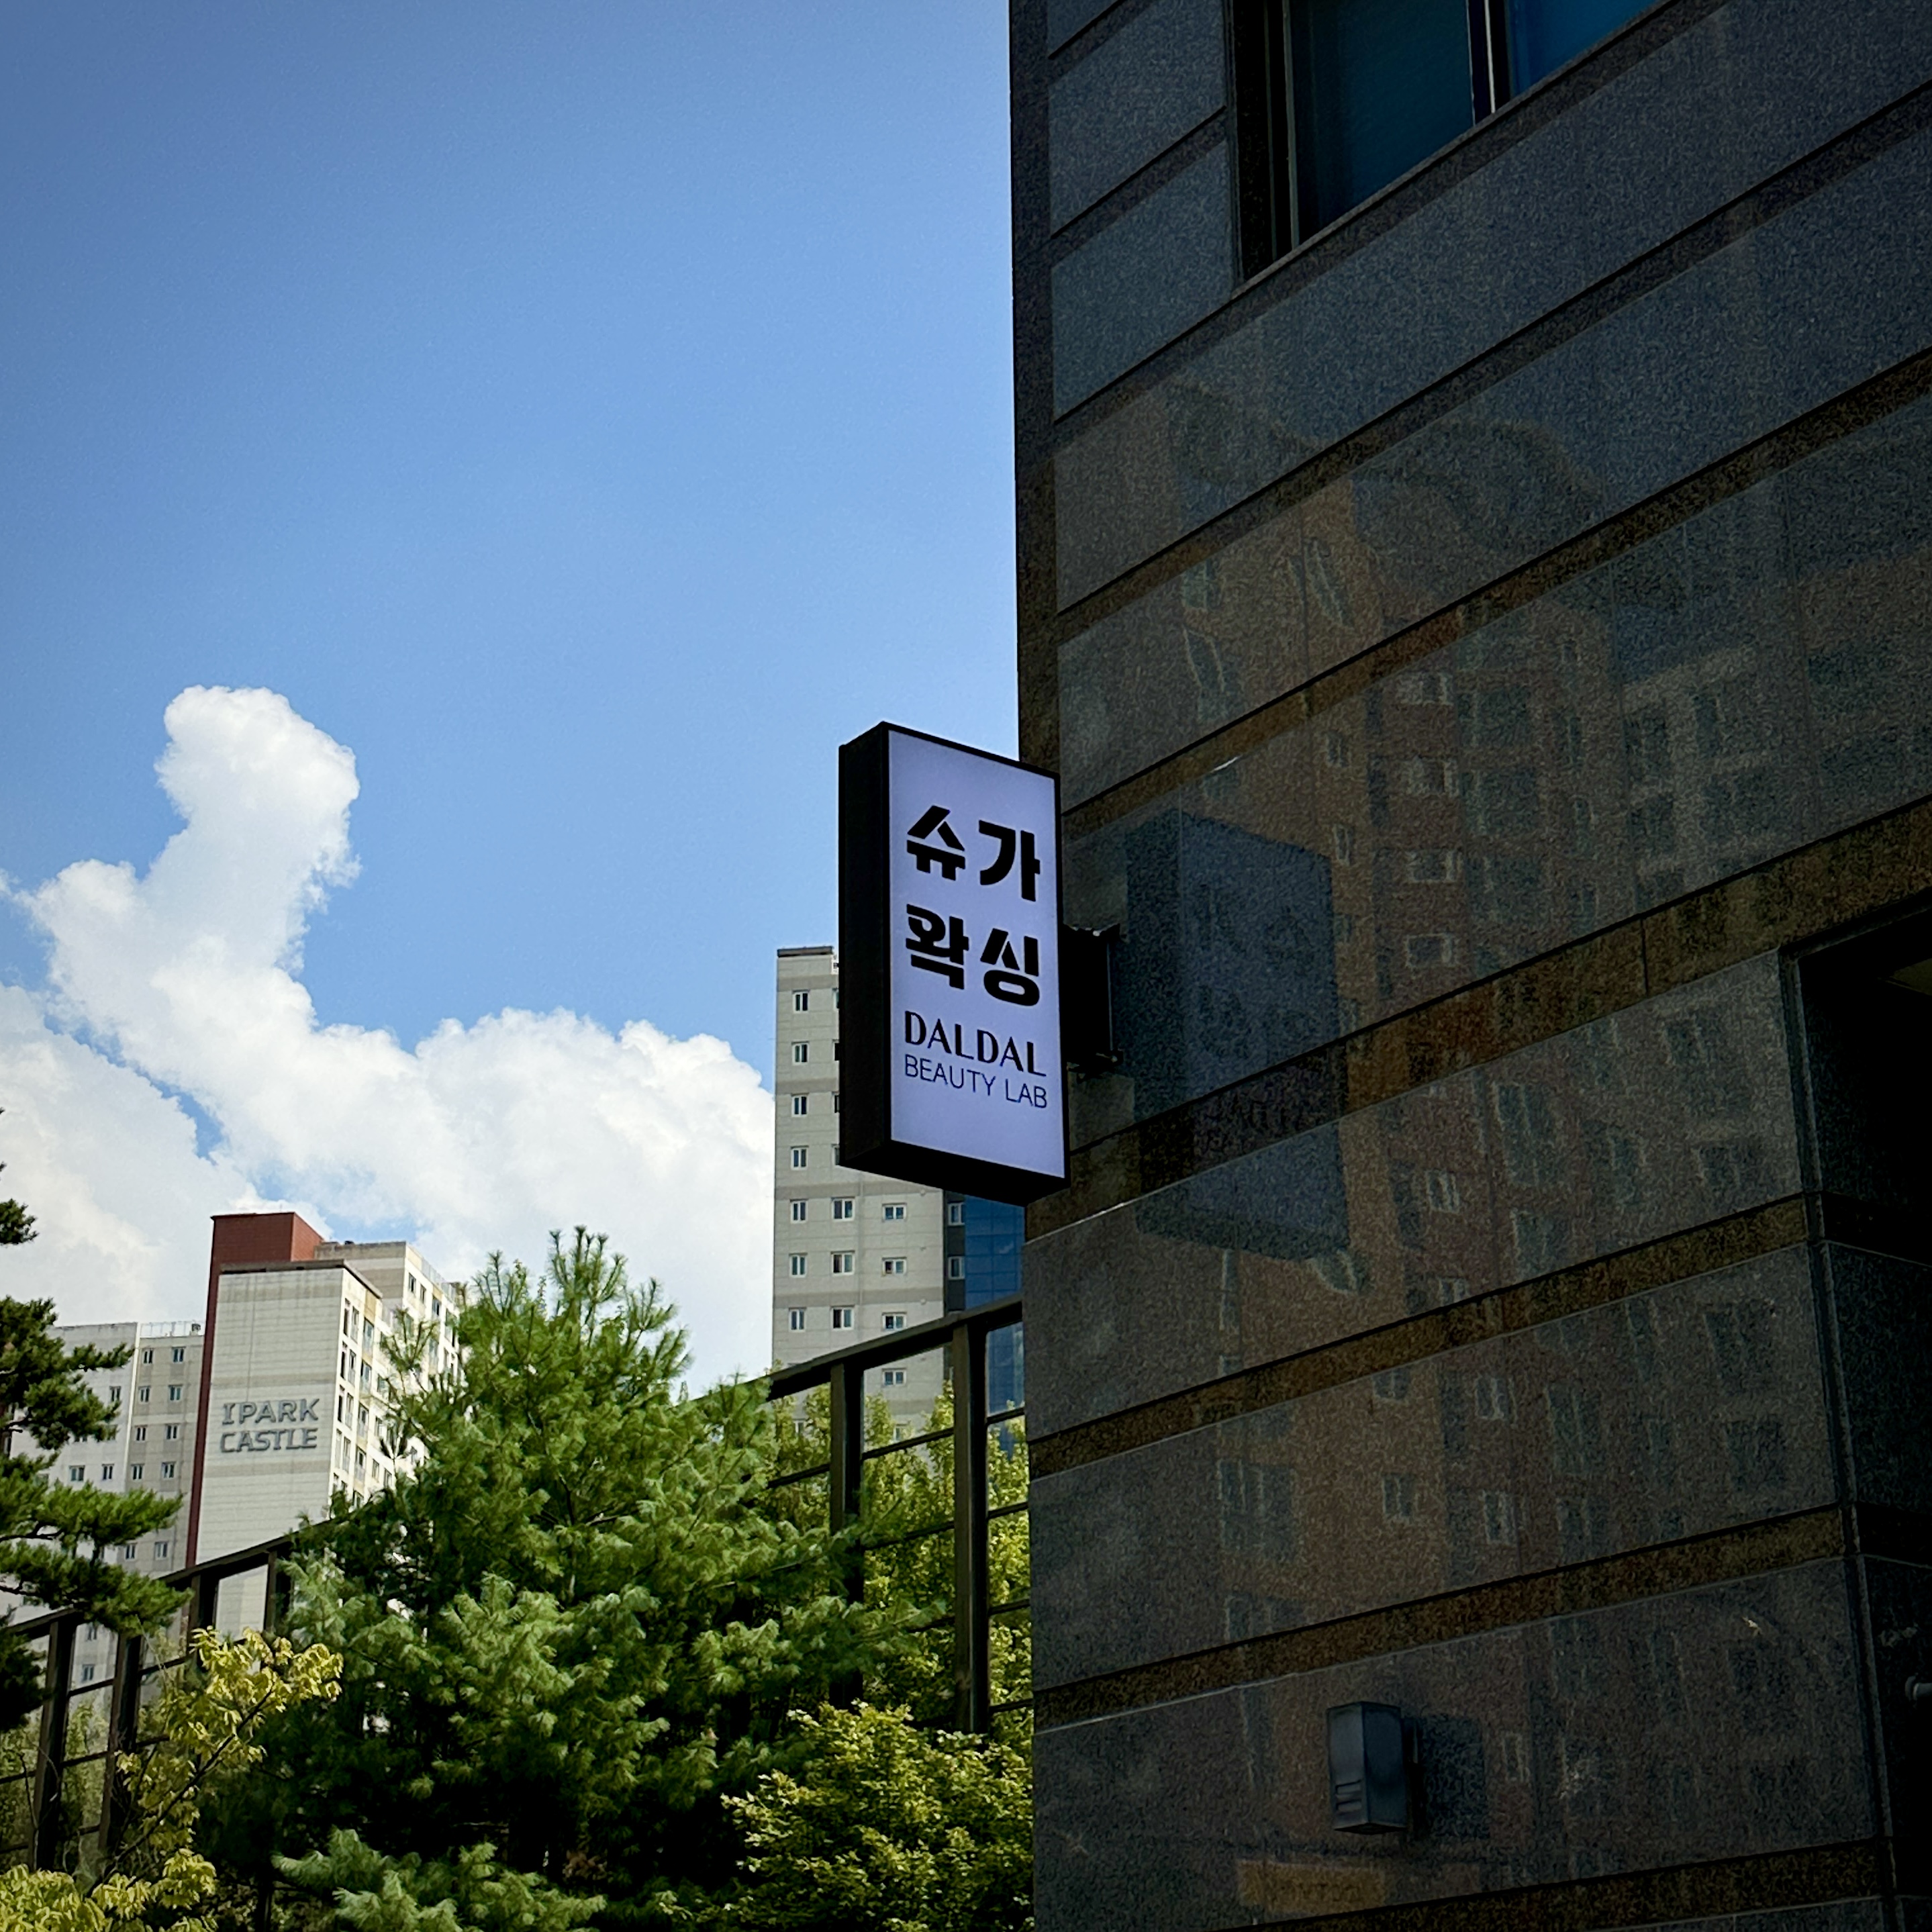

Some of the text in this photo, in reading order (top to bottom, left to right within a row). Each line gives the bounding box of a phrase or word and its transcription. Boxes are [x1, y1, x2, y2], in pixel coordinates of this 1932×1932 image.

[906, 804, 1041, 902] 슈가
[905, 903, 1041, 1007] 왁싱
[904, 1010, 1047, 1077] DALDAL
[904, 1053, 1048, 1109] BEAUTY LAB
[220, 1428, 318, 1453] CASTLE
